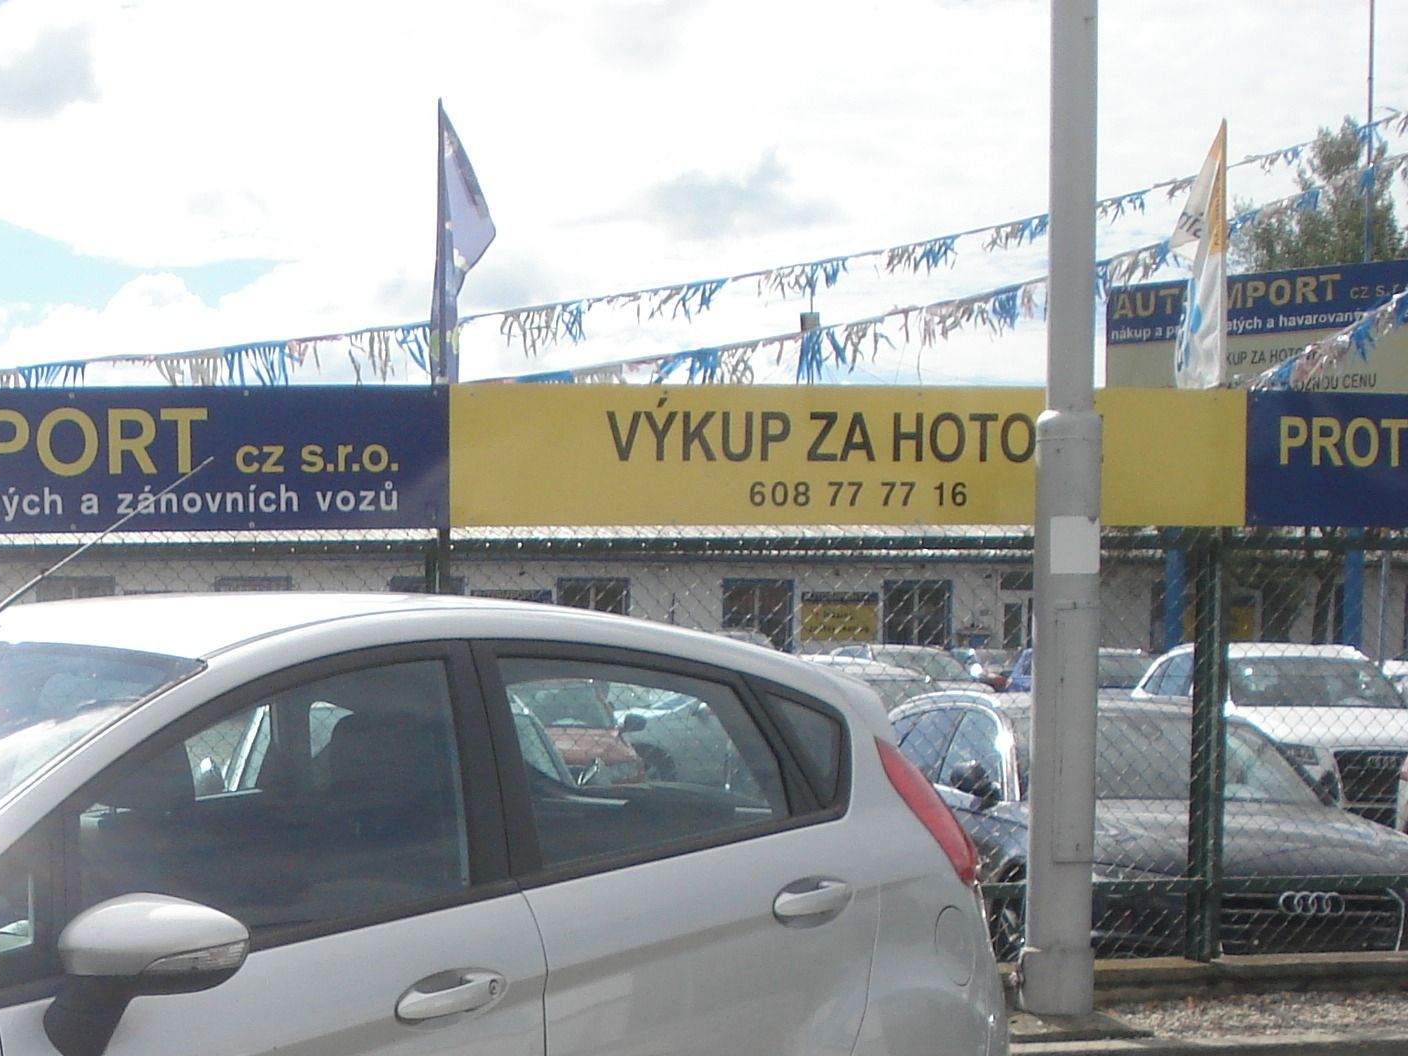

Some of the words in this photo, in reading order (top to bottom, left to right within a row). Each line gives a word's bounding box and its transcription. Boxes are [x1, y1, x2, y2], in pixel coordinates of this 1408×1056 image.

[1113, 274, 1341, 319] AUTMPORT
[1112, 326, 1152, 341] nákup
[1266, 317, 1275, 328] a
[1251, 351, 1266, 365] ZA
[1342, 373, 1377, 389] CENU
[605, 396, 791, 462] VÝKUP
[807, 411, 875, 463] ZA
[893, 411, 1036, 464] HOTO
[235, 443, 285, 473] cz
[300, 442, 399, 473] s.r.o.
[80, 494, 99, 515] a
[117, 483, 299, 515] zánovních
[316, 480, 399, 512] vozů
[748, 481, 812, 508] 608
[828, 481, 864, 508] 77
[881, 481, 917, 508] 77
[935, 481, 968, 508] 16
